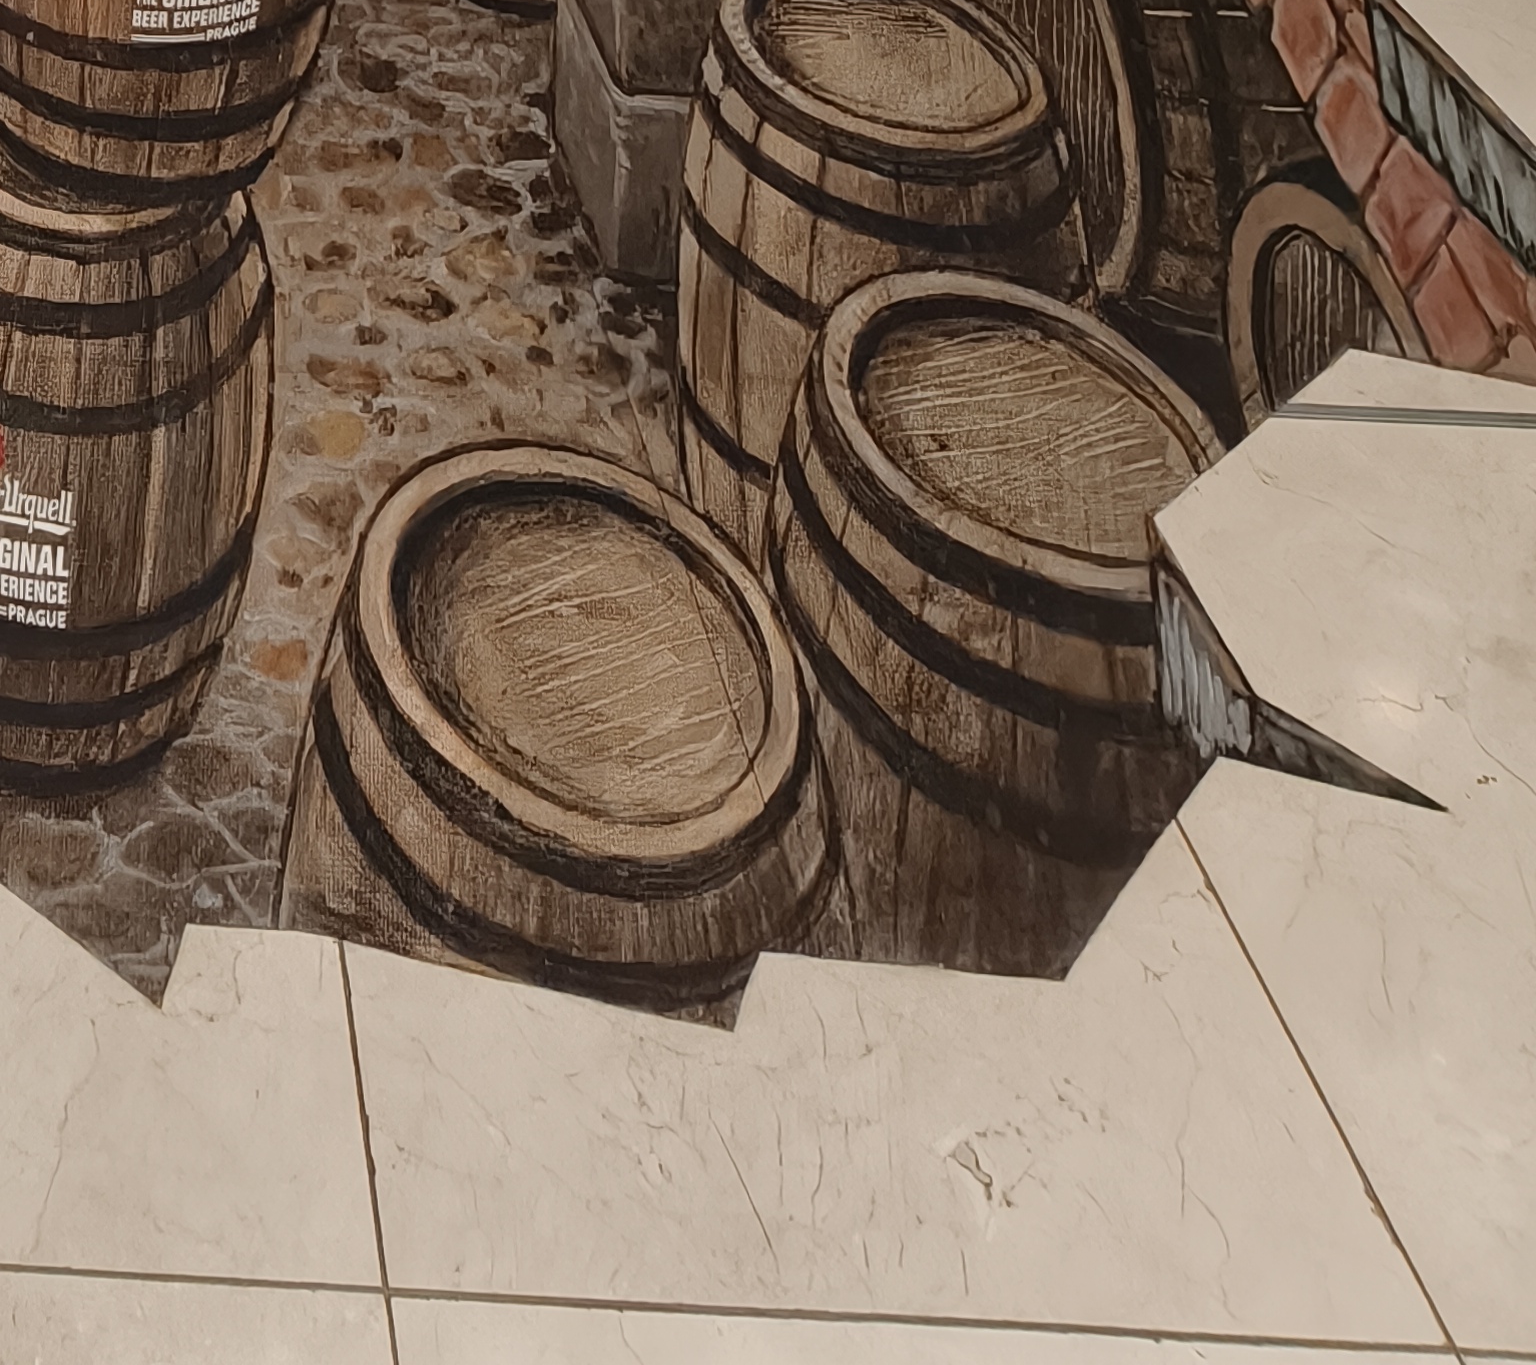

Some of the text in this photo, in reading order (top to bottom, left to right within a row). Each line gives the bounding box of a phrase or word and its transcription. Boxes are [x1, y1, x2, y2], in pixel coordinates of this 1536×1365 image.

[132, 9, 168, 28] BEER
[205, 16, 257, 41] PRAGUE
[4, 474, 73, 533] Urquell
[7, 603, 67, 630] PRAGUE
